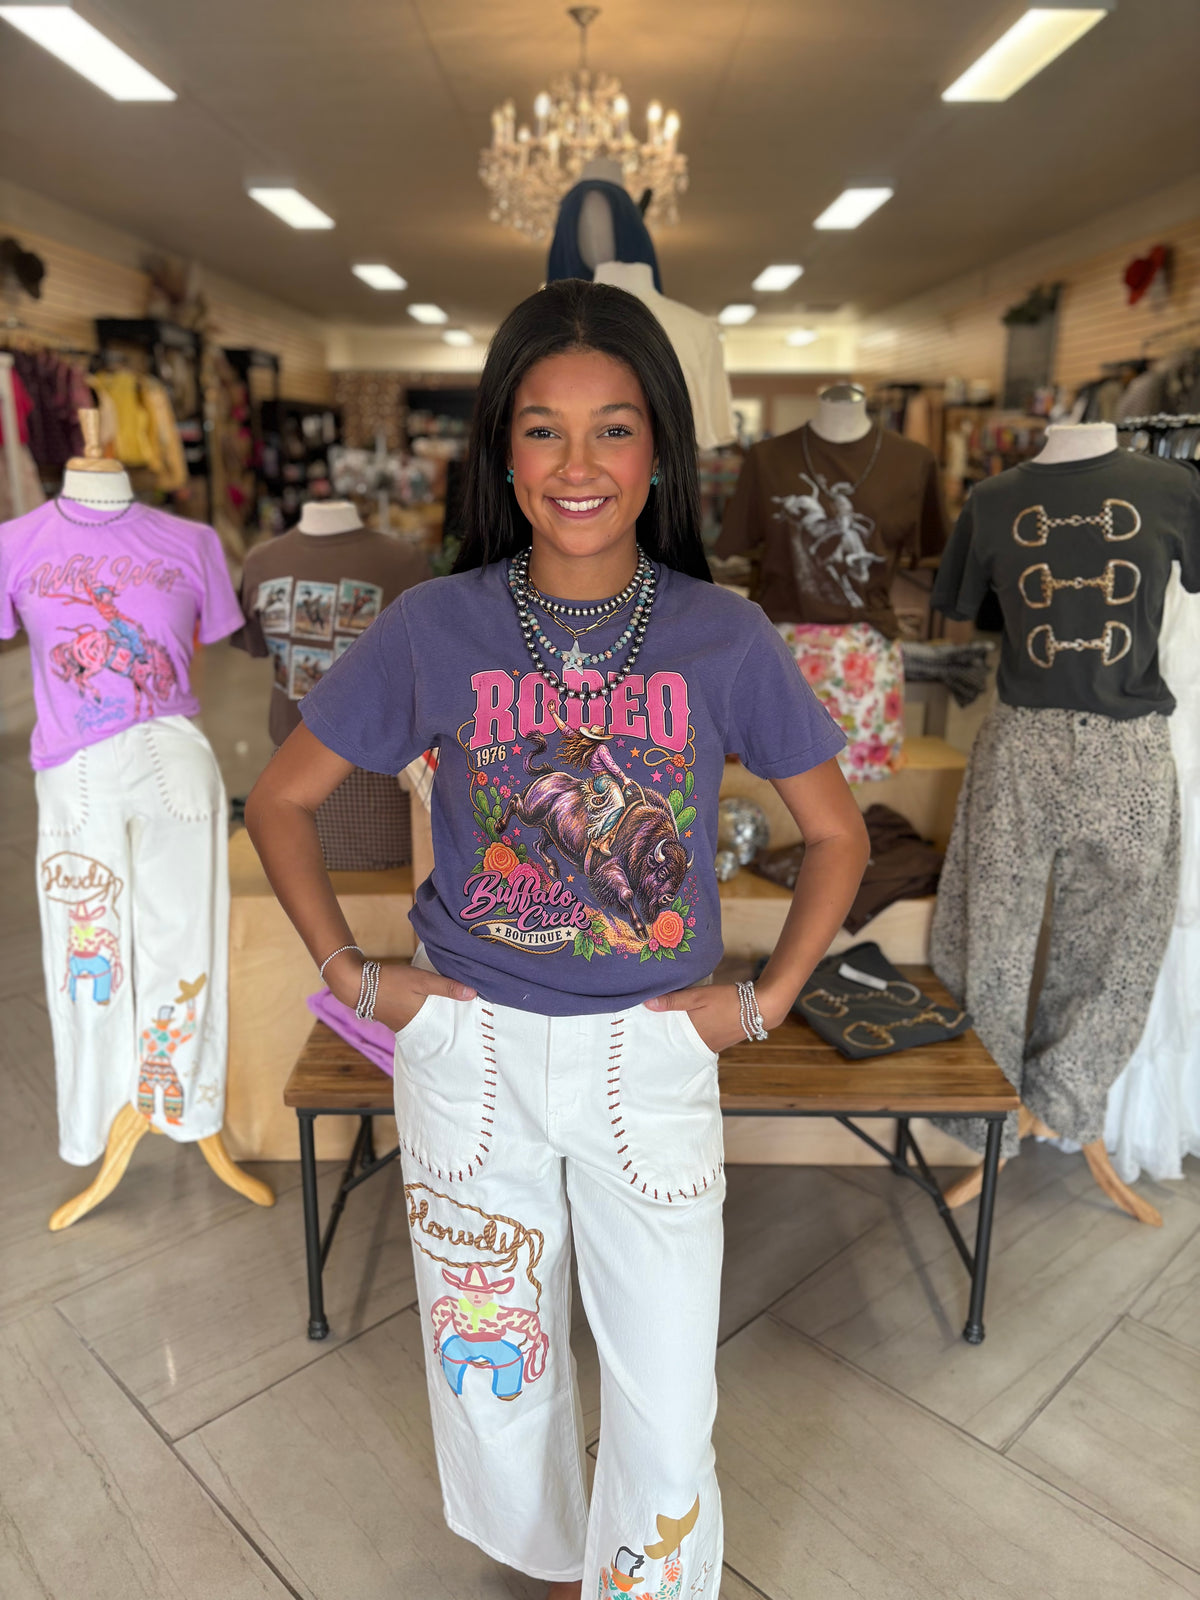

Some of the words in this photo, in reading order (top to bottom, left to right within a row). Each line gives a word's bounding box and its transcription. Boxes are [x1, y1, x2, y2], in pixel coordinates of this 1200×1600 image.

[469, 669, 691, 752] RODEO
[476, 745, 507, 768] 1976
[41, 864, 115, 902] Howdy
[460, 869, 576, 922] Buffalo
[504, 927, 563, 944] BOUTIQUE
[516, 906, 592, 931] Creek
[405, 1190, 526, 1273] Howdy
